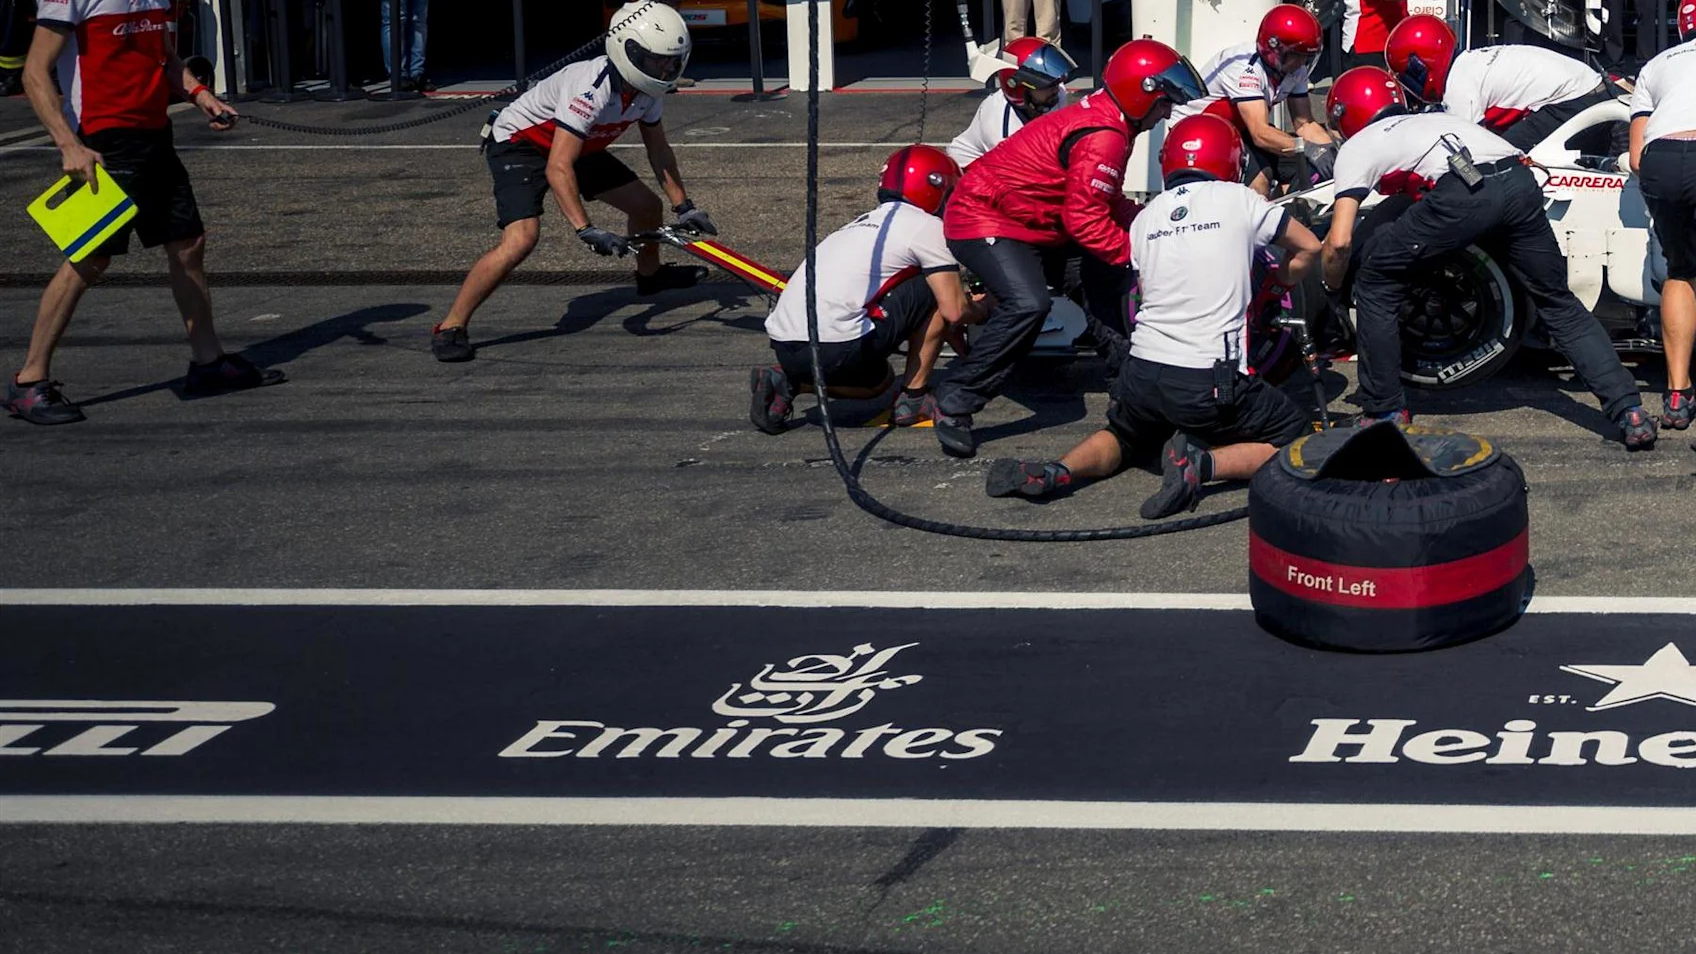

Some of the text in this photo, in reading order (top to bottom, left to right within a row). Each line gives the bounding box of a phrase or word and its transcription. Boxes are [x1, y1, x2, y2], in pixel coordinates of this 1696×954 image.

[1549, 175, 1624, 188] CARRERA
[1191, 220, 1221, 233] Team
[1287, 564, 1377, 598] Front Left
[1528, 693, 1578, 704] EST.
[497, 719, 1003, 759] Emirates
